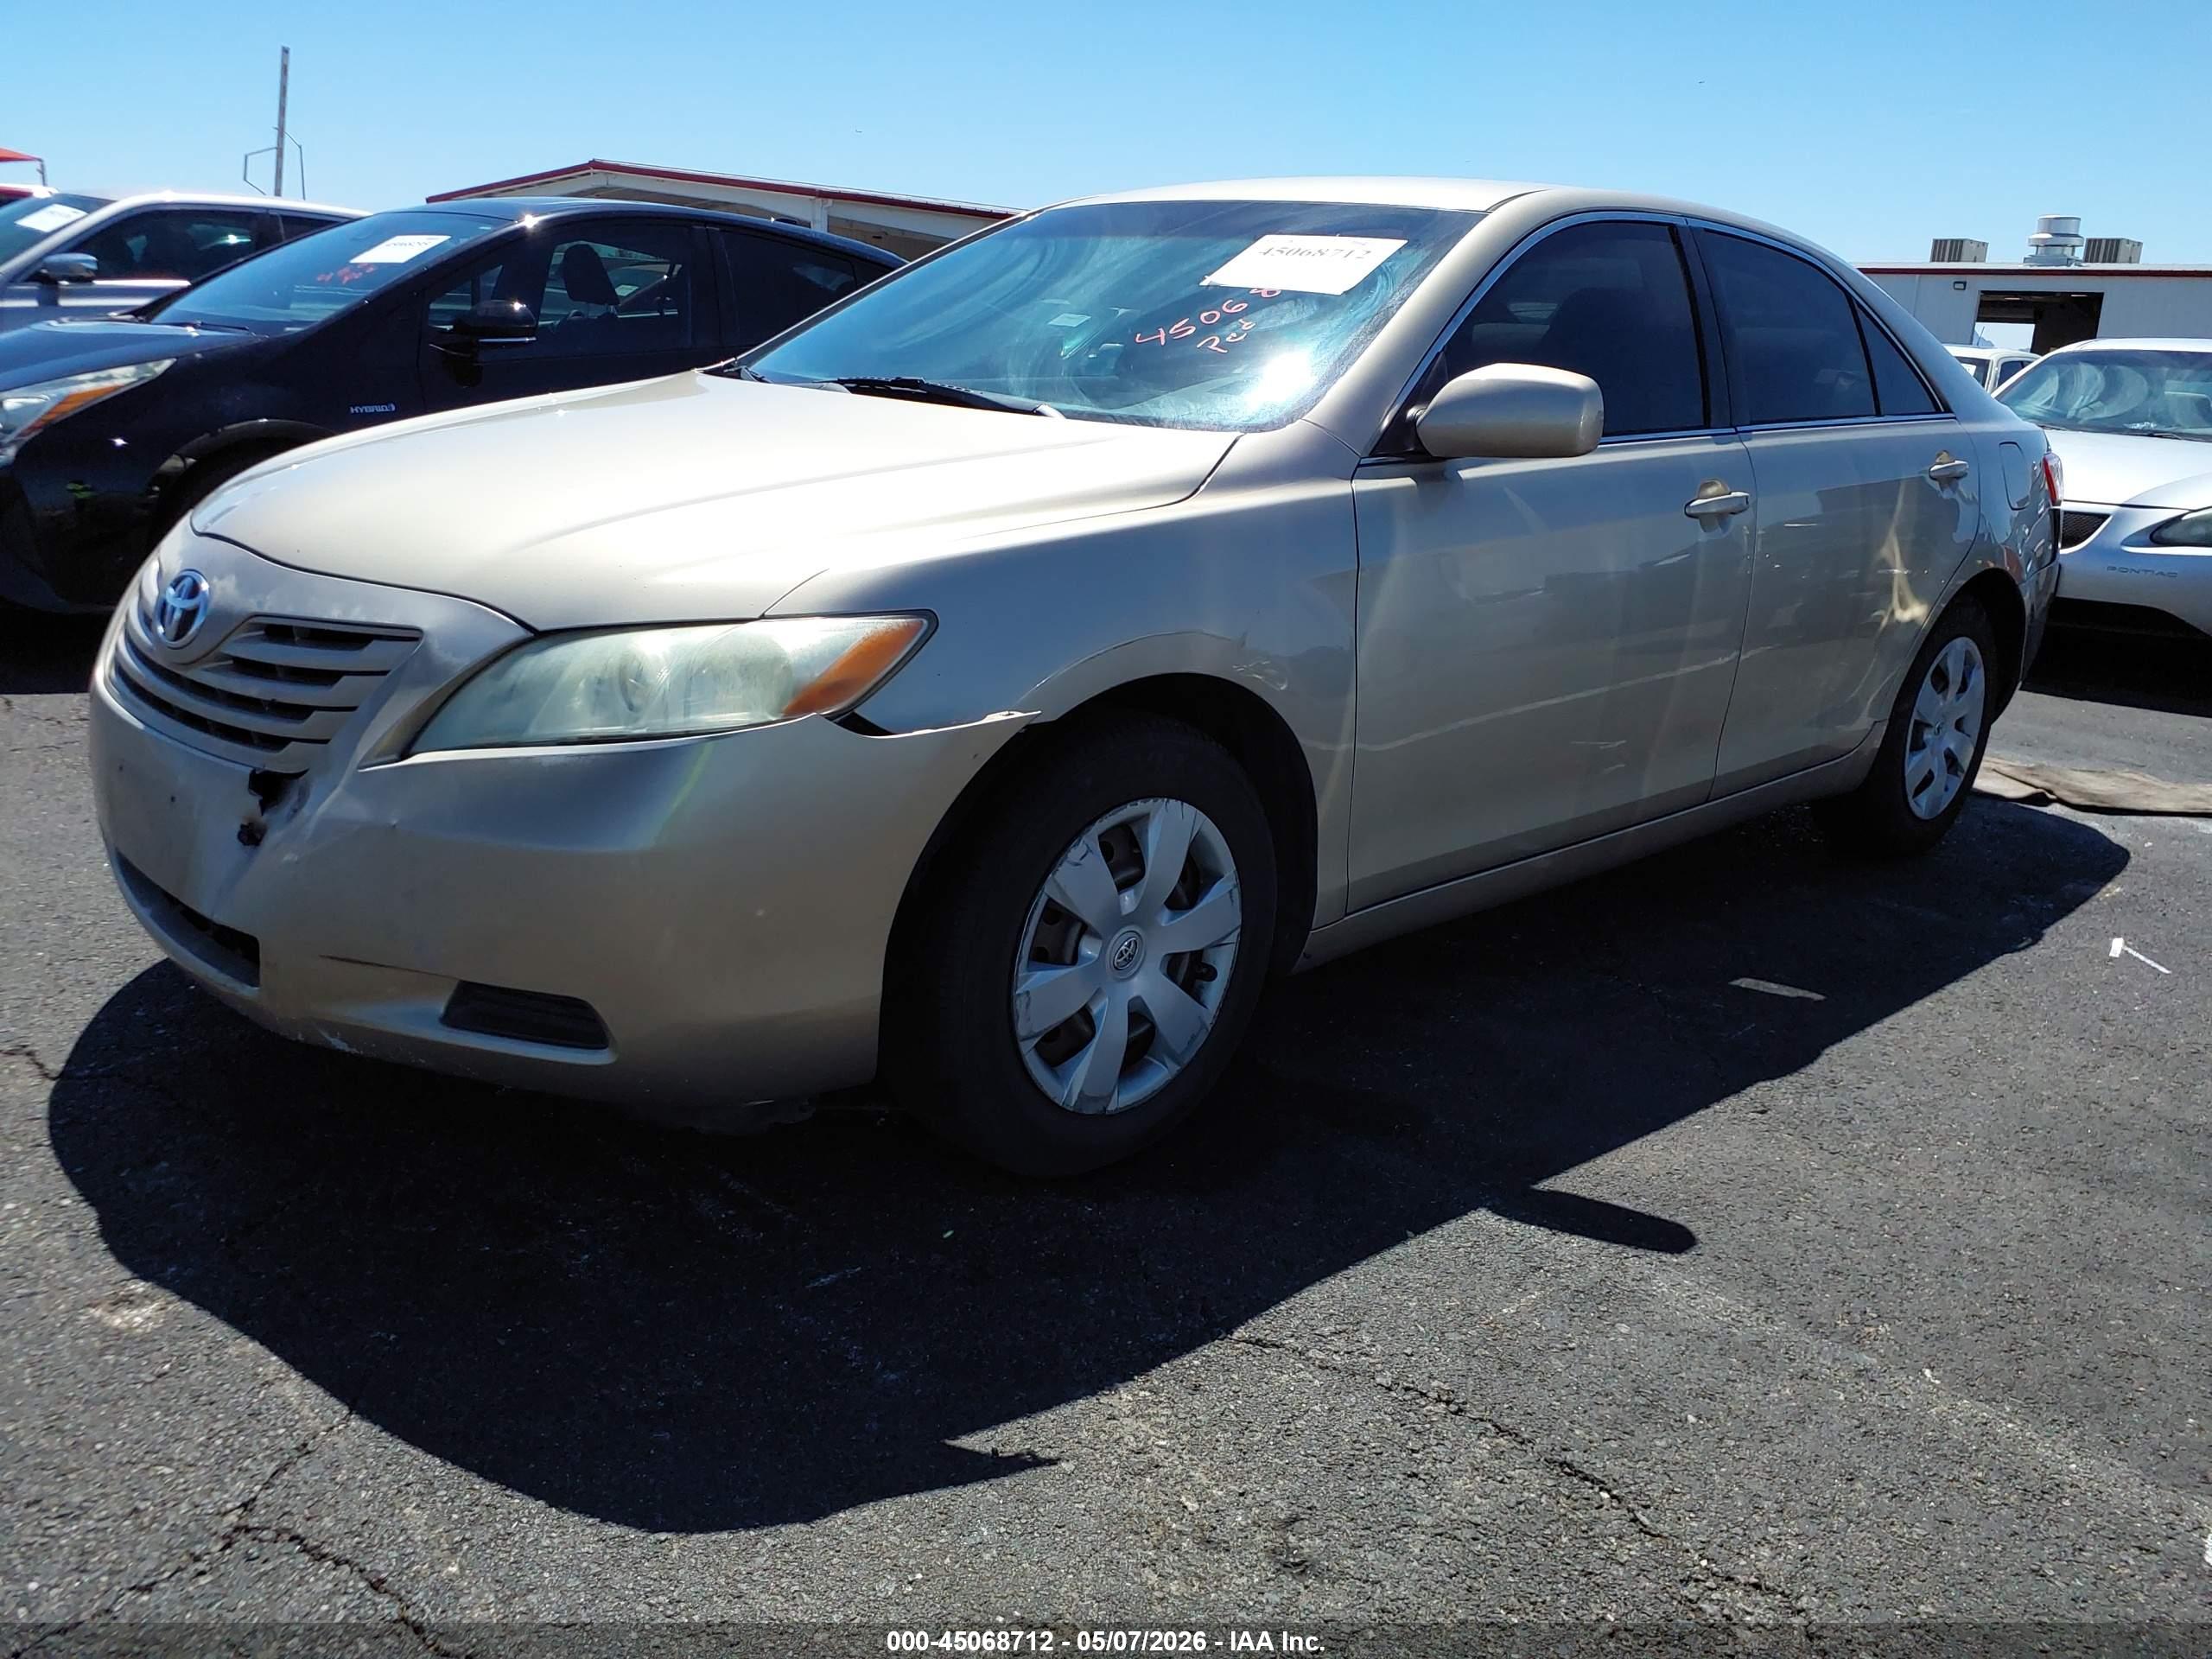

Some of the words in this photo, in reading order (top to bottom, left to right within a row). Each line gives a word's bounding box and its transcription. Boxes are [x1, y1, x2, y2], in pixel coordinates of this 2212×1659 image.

[1258, 246, 1372, 259] 45068712
[350, 404, 390, 414] HYBRID
[2106, 566, 2178, 578] PONTIAC
